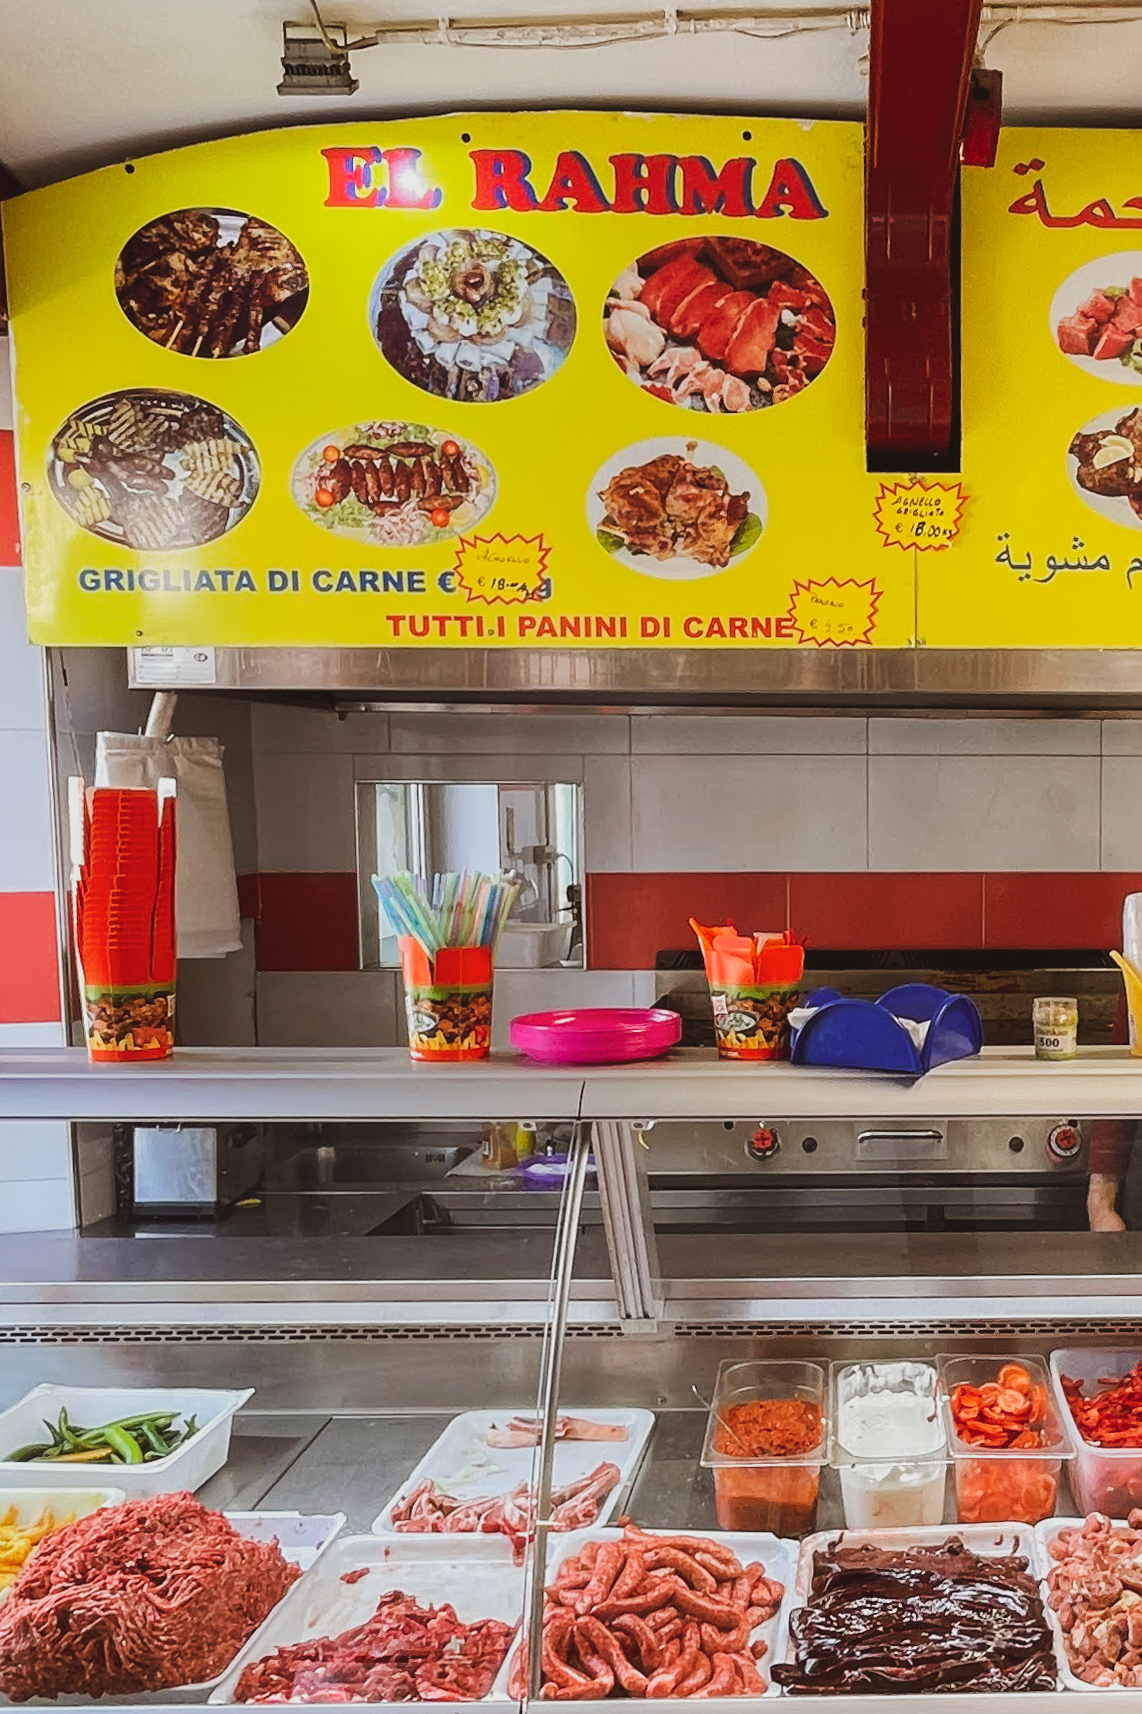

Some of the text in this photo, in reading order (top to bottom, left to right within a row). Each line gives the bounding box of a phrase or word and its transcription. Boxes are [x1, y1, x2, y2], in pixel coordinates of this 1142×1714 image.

[321, 146, 829, 219] EL RAHMA
[995, 531, 1111, 583] مشوية
[79, 569, 457, 594] GRIGLIATA DI CARNE €
[386, 615, 793, 639] TUTTI I PANINI DI CARNE
[1039, 1037, 1060, 1047] 500
